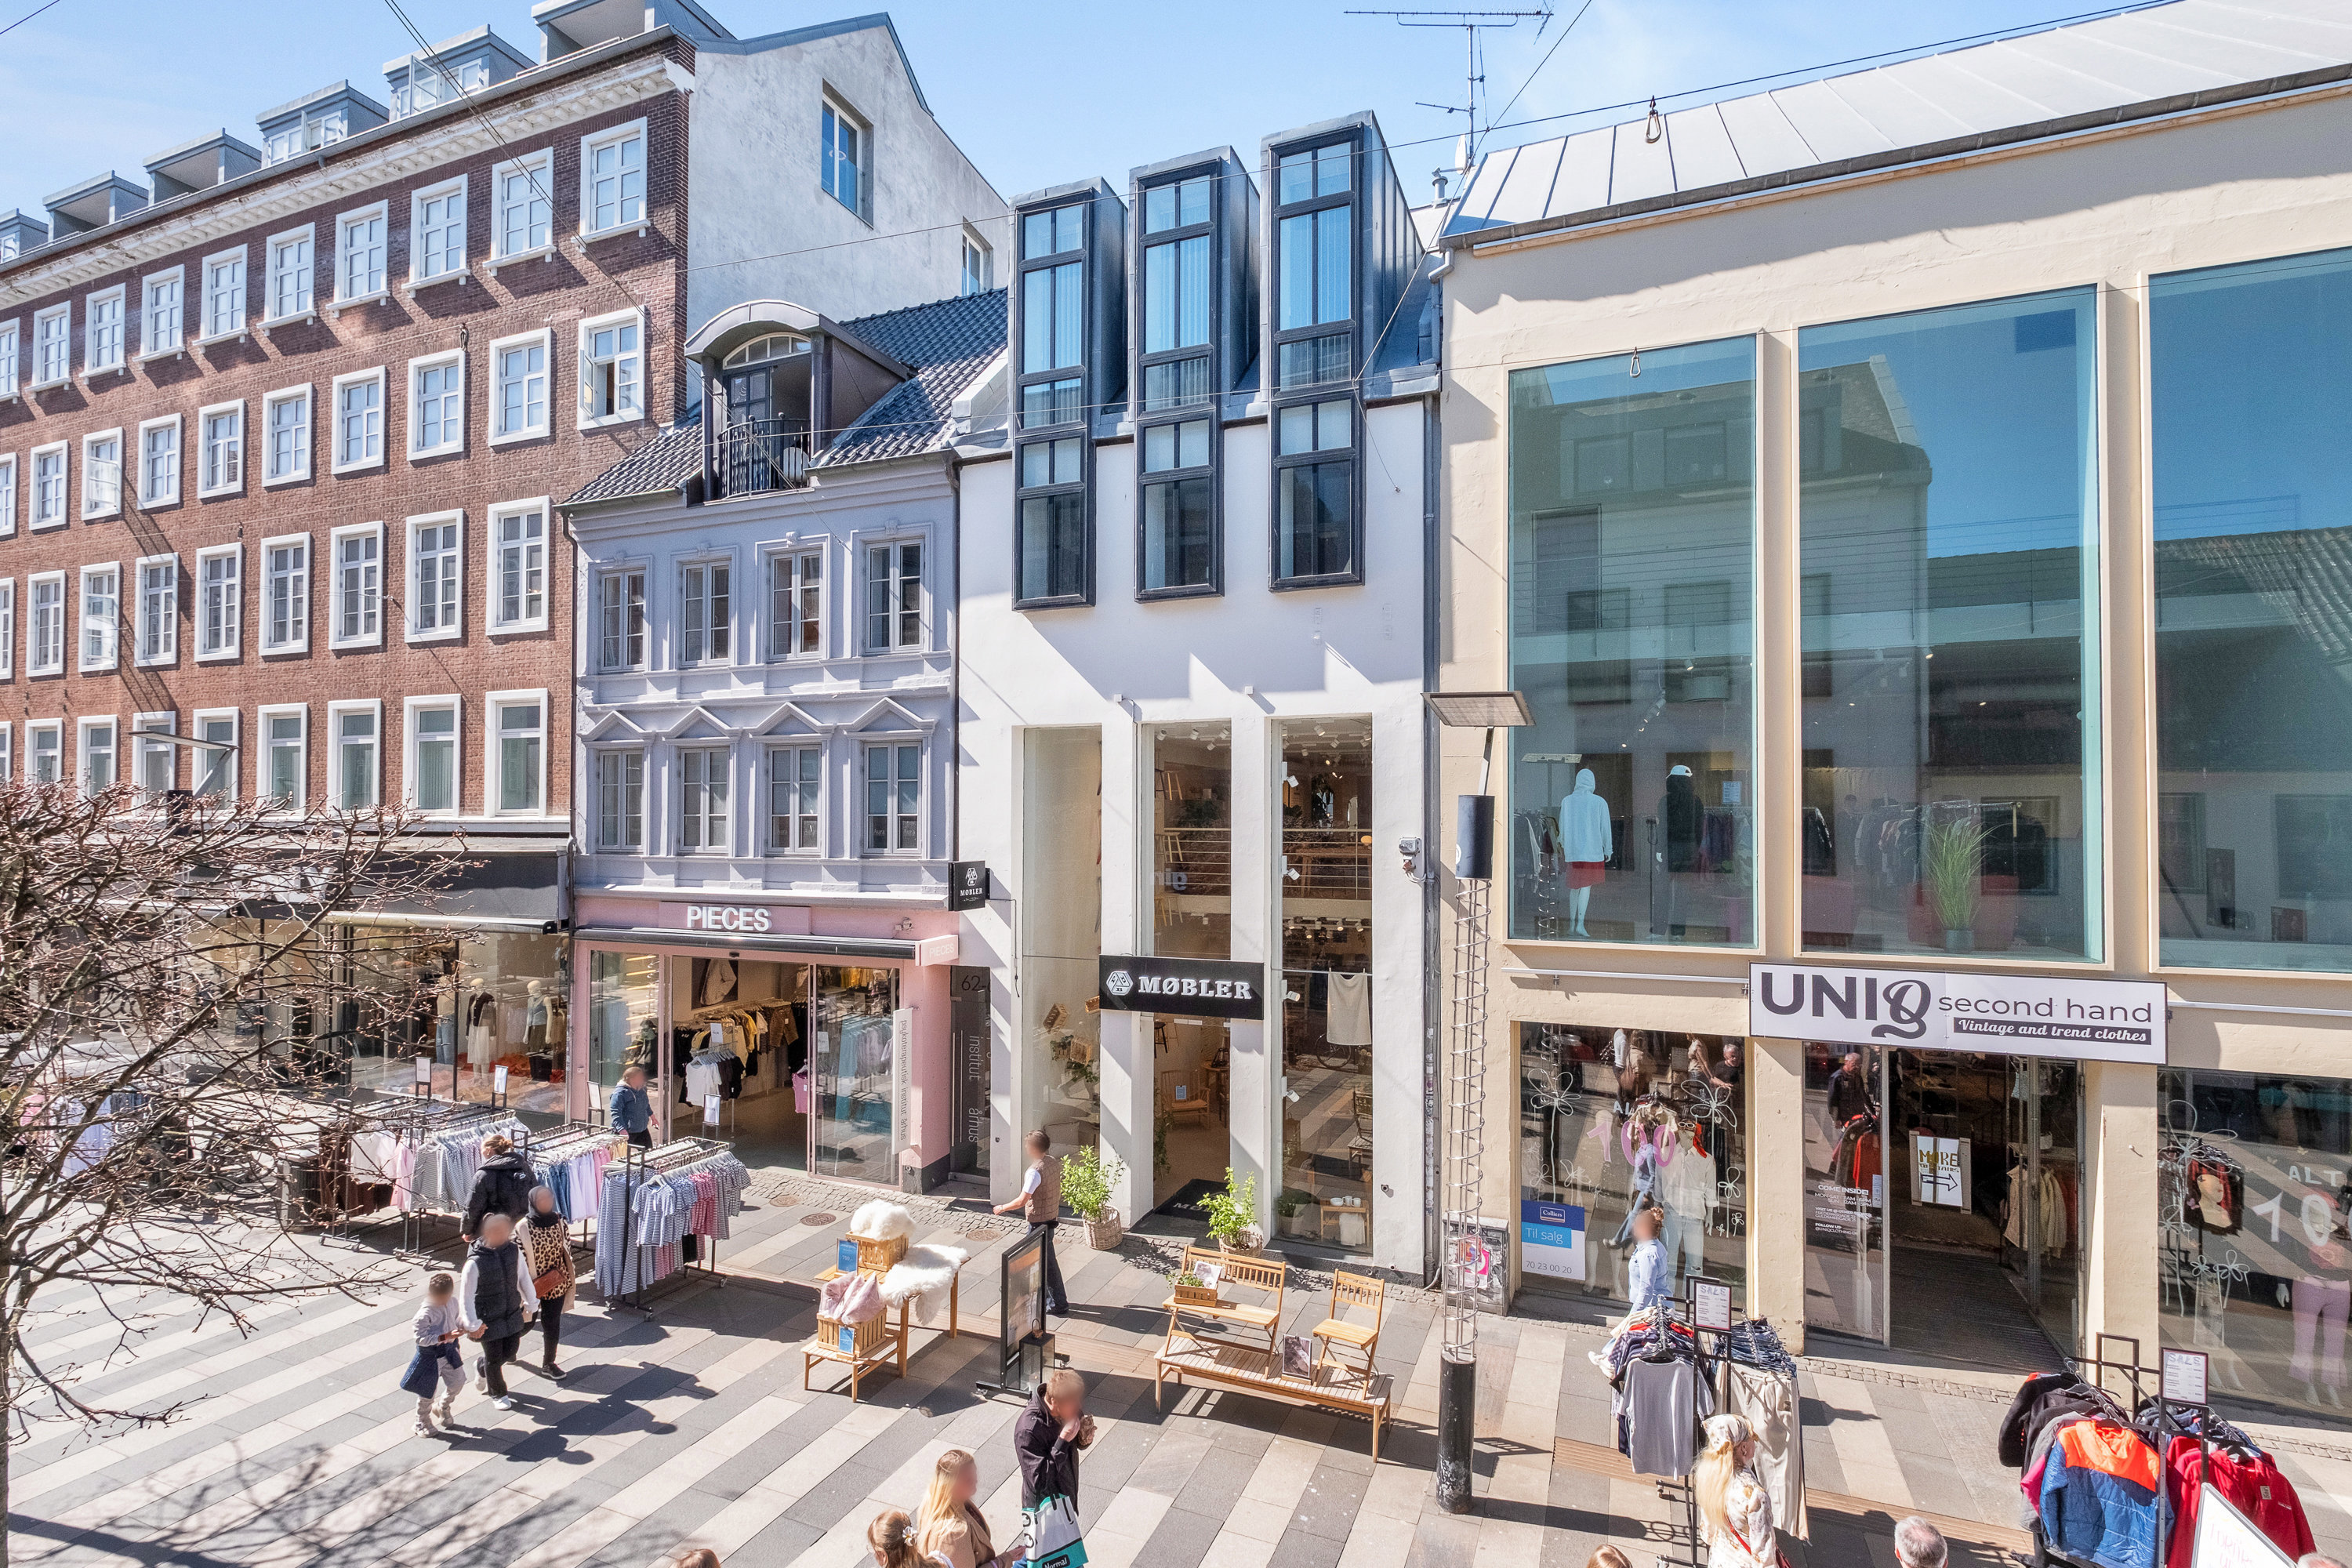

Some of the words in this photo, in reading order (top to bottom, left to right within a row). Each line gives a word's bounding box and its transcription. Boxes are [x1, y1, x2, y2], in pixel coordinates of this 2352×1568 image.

[687, 906, 771, 931] PIECES
[928, 942, 955, 959] PIECES
[961, 975, 991, 991] 62-
[1138, 975, 1252, 1000] MØBLER
[1761, 971, 1932, 1040] UNIQ
[1938, 996, 2053, 1018] second
[2067, 998, 2151, 1023] hand
[1958, 1019, 2015, 1036] Vintage
[2018, 1023, 2047, 1036] and
[2051, 1025, 2092, 1039] trend
[2095, 1029, 2147, 1042] clothes
[969, 1036, 983, 1080] institut
[968, 1108, 983, 1143] århus
[1586, 1120, 1676, 1167] 100
[1918, 1149, 1958, 1167] MORE
[2288, 1165, 2343, 1187] ALT
[2252, 1190, 2352, 1247] 10
[1525, 1228, 1537, 1239] Til
[1541, 1231, 1563, 1245] salg
[1525, 1260, 1536, 1269] 70
[1537, 1262, 1548, 1271] 23
[1549, 1264, 1560, 1272] 00
[1562, 1265, 1573, 1274] 20
[1044, 1557, 1068, 1568] Normal
